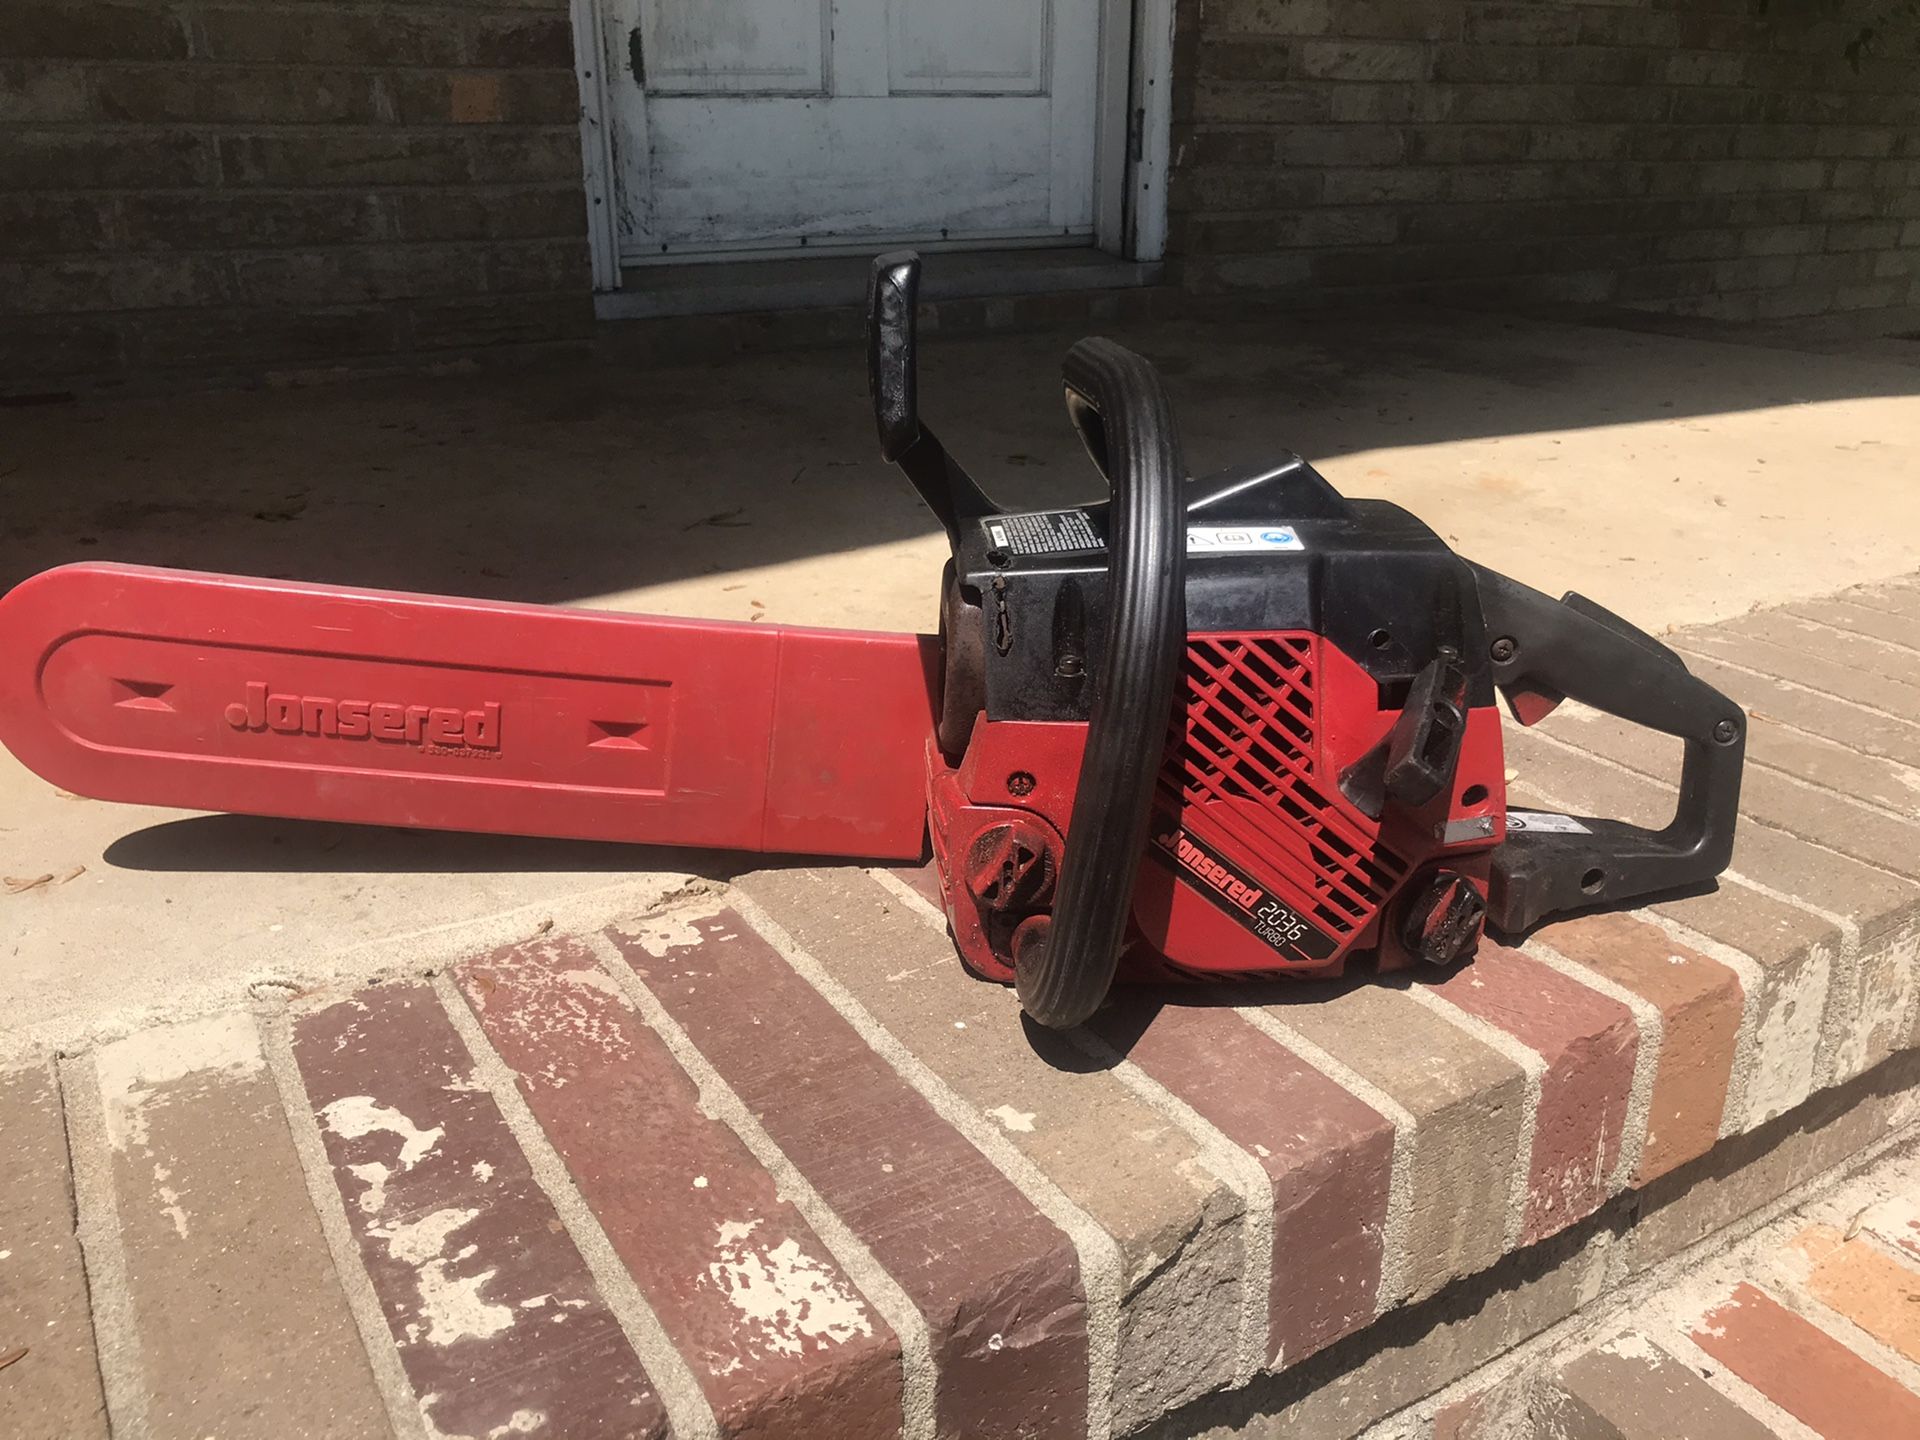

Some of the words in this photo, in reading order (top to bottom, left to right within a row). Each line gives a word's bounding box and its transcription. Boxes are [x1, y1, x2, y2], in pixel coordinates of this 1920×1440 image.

[225, 681, 501, 749] Jonsered
[1158, 831, 1263, 909] Jonsered
[1257, 901, 1308, 940] 2036
[1254, 920, 1286, 947] TURBO
